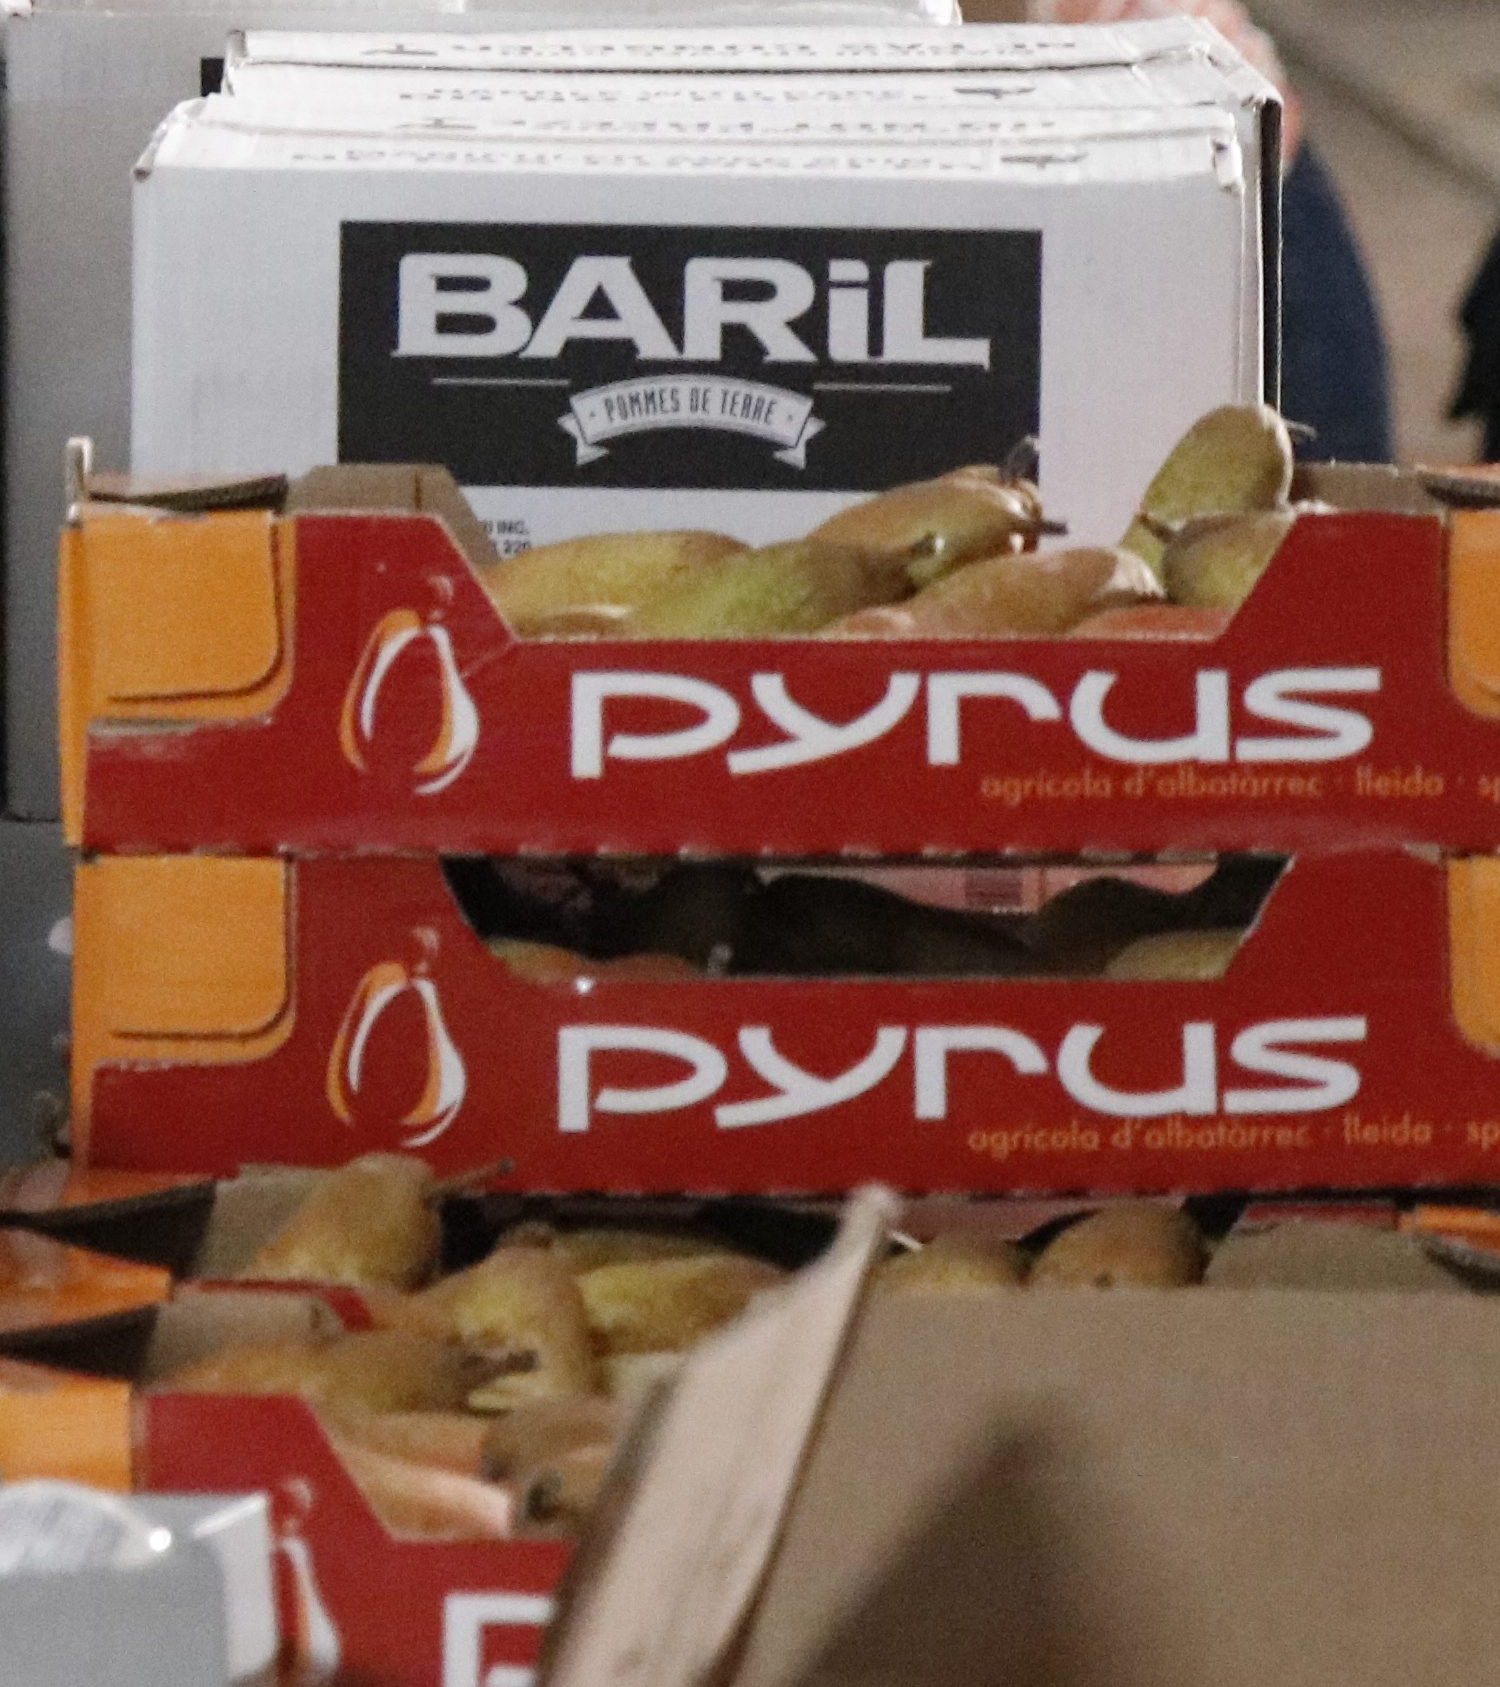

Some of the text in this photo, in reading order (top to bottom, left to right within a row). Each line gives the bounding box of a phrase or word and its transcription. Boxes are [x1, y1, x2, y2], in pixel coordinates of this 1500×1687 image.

[604, 388, 776, 425] POMMES DE TERRE
[571, 667, 1381, 779] pyrus
[558, 1016, 1367, 1132] pyrus
